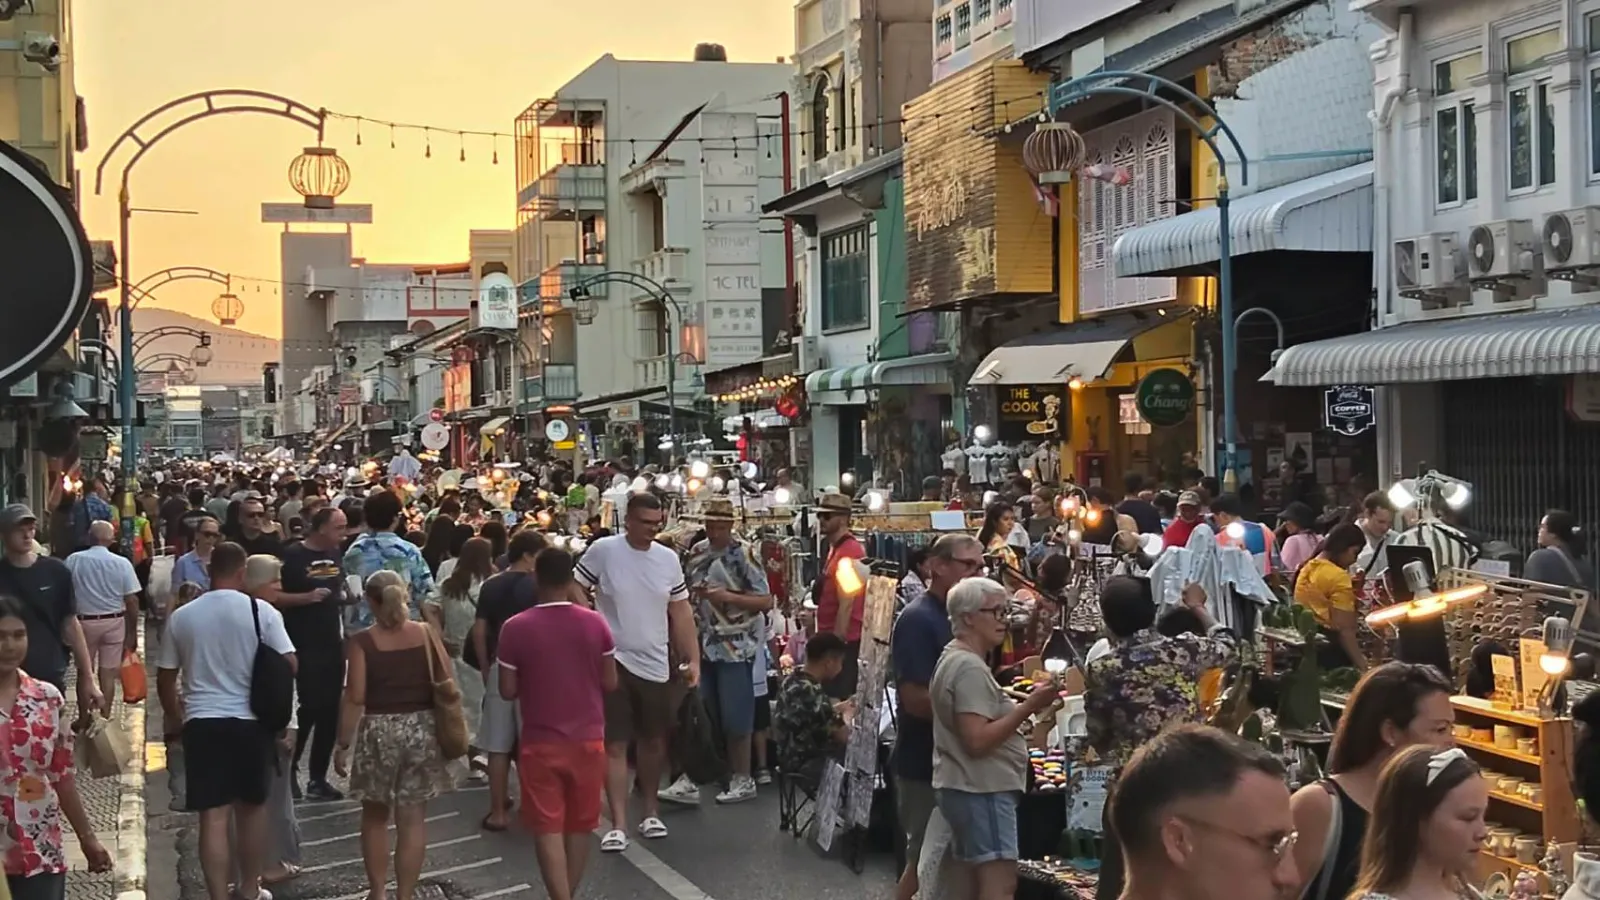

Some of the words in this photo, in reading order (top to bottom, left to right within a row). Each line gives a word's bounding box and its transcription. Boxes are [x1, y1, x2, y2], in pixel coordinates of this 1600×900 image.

[1010, 388, 1031, 400] THE
[1001, 401, 1039, 413] COOK
[1144, 394, 1187, 411] Chang
